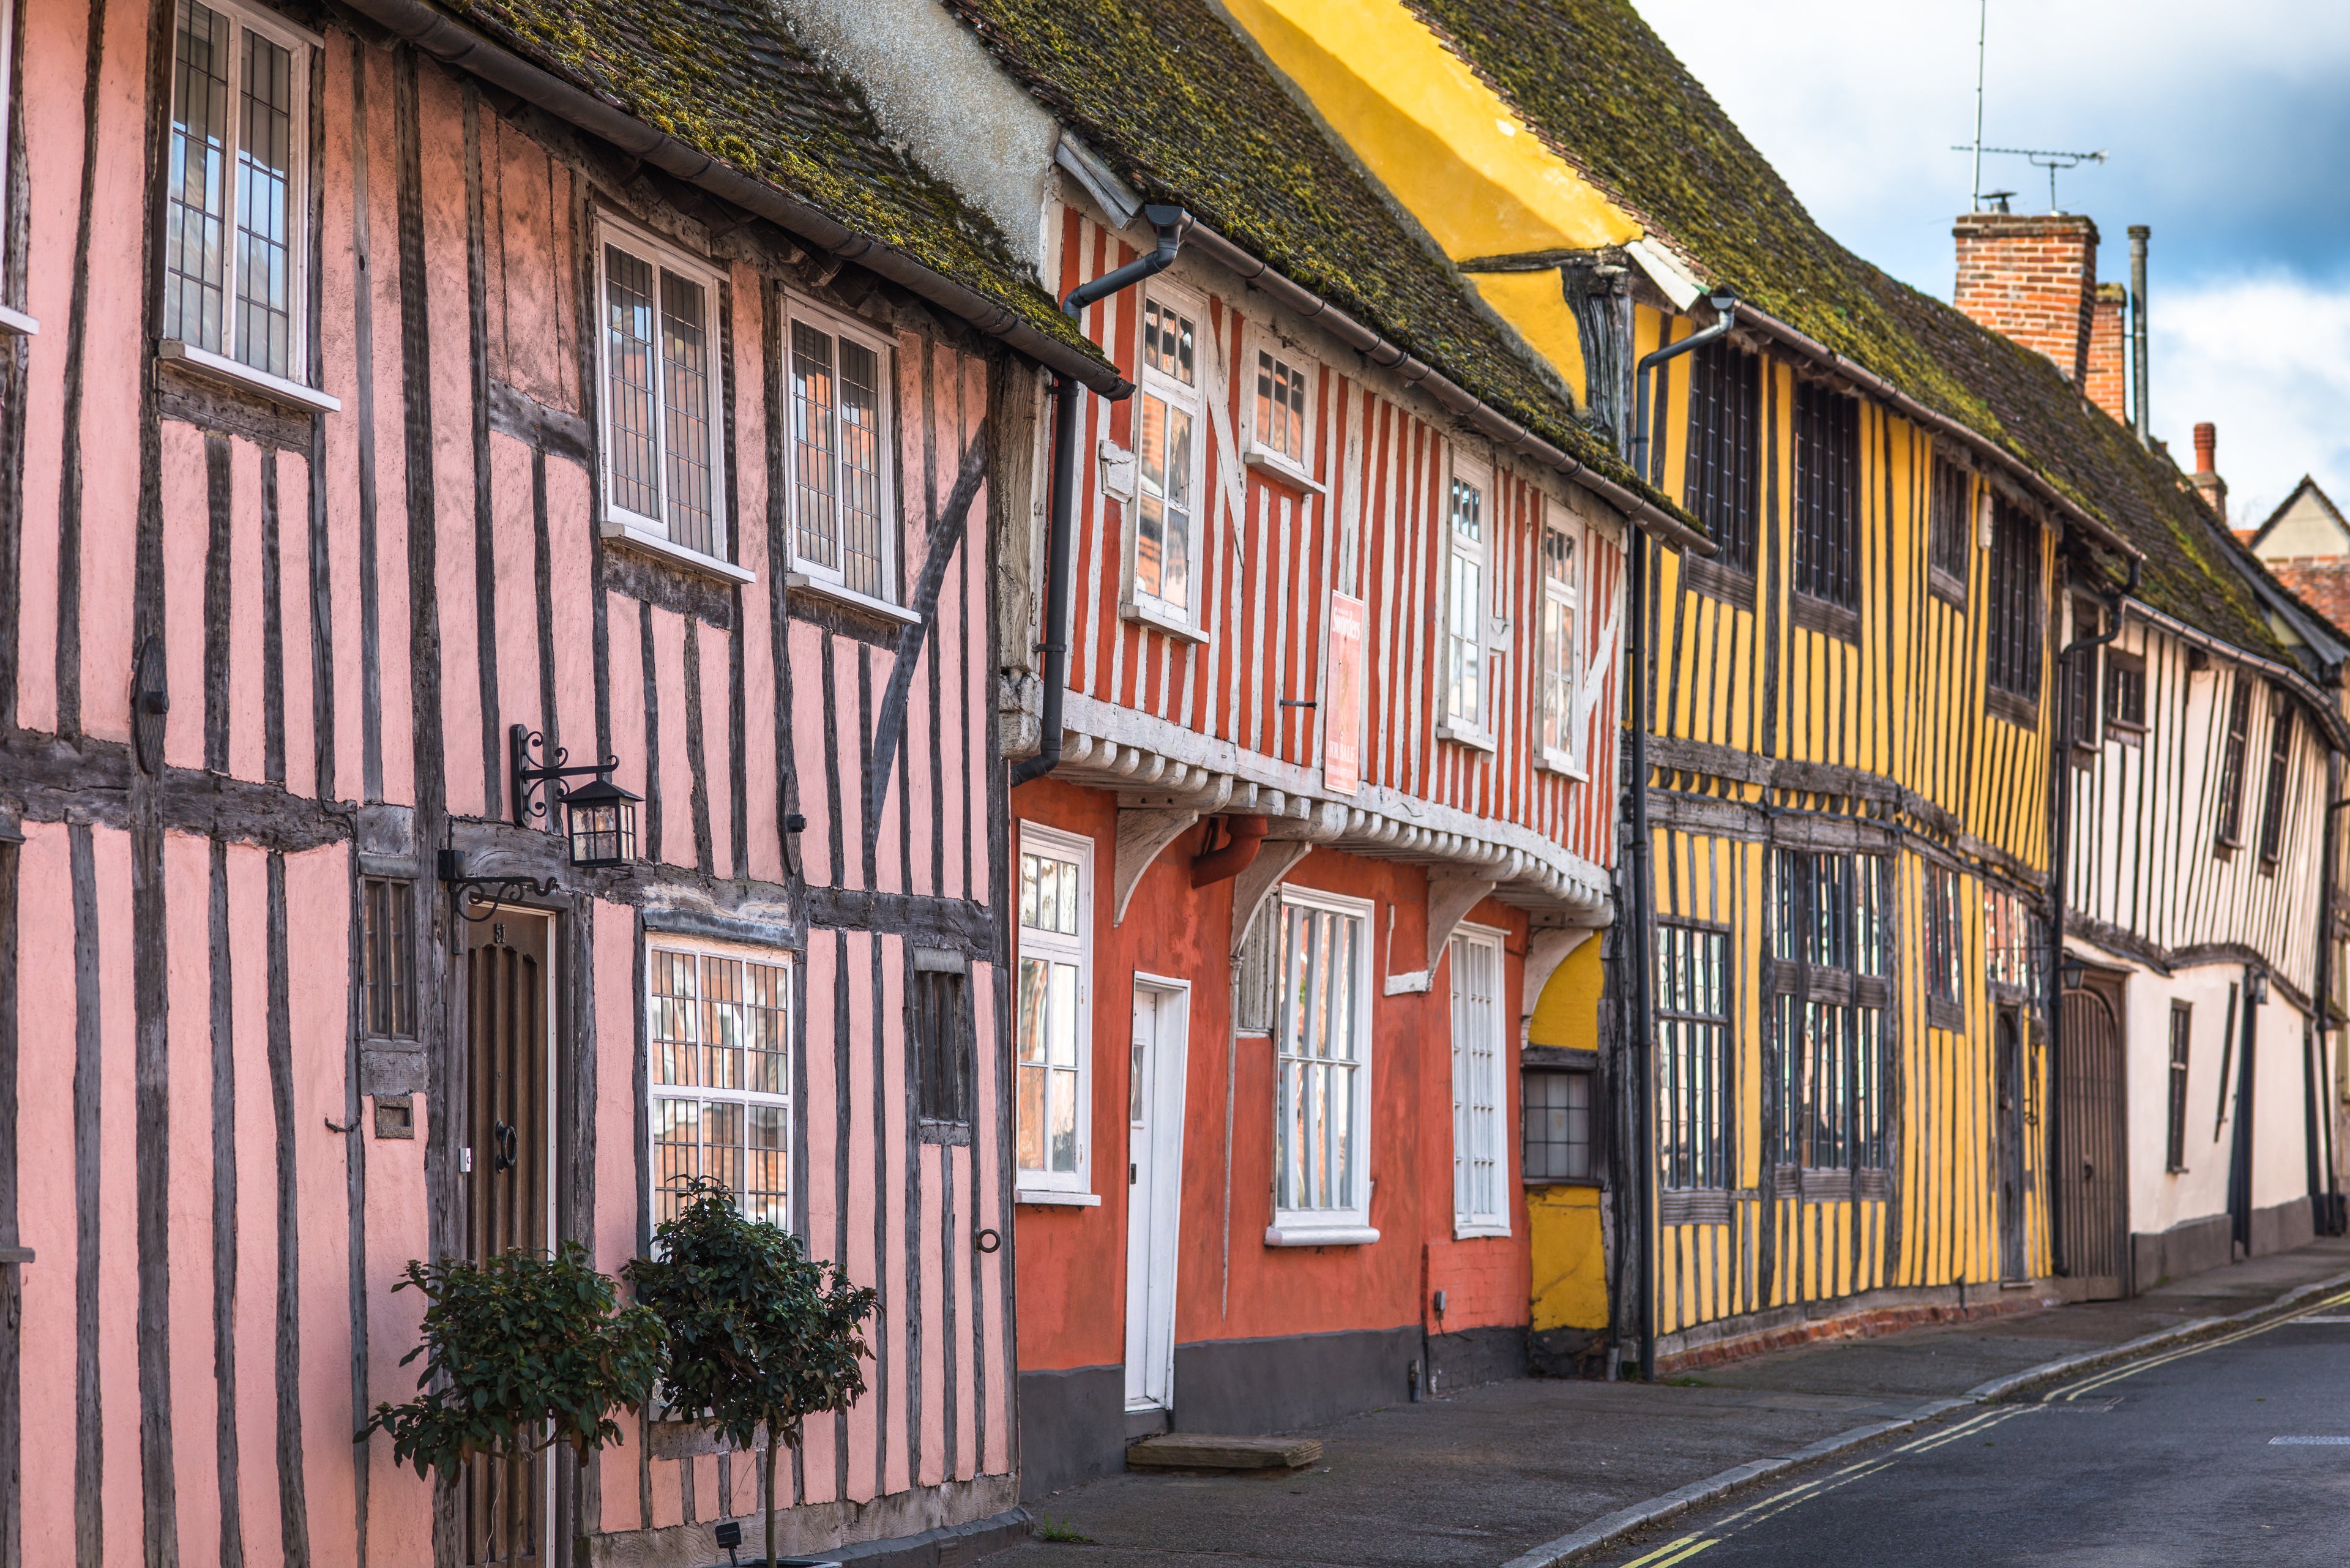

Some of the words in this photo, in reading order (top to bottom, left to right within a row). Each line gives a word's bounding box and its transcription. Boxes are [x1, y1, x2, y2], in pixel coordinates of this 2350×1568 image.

[1333, 607, 1360, 640] Sworders
[1329, 741, 1339, 759] FOR
[1340, 743, 1355, 763] SALE
[494, 923, 506, 944] 51
